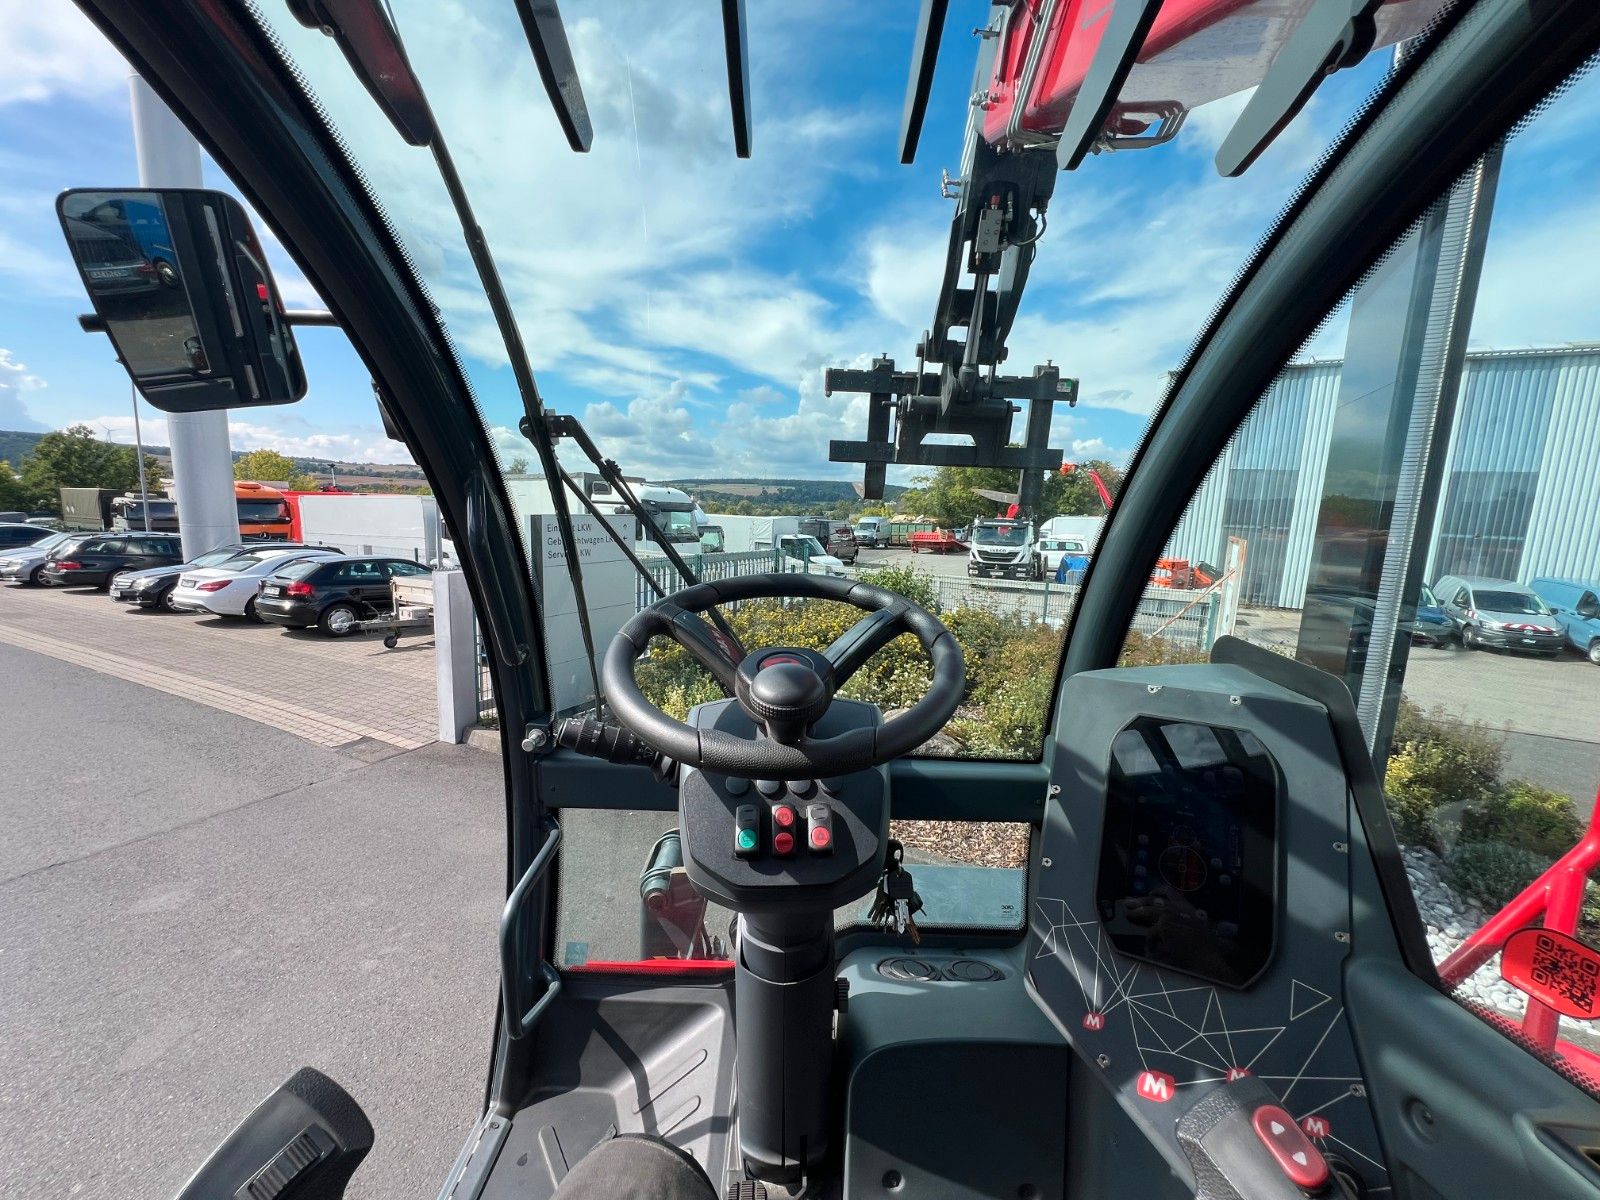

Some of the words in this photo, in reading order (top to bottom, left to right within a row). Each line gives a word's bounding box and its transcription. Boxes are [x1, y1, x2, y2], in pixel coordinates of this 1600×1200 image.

[577, 523, 592, 532] LKW
[578, 549, 592, 557] KW
[1087, 1013, 1100, 1029] M
[1143, 1072, 1168, 1101] M
[1306, 1117, 1325, 1136] M
